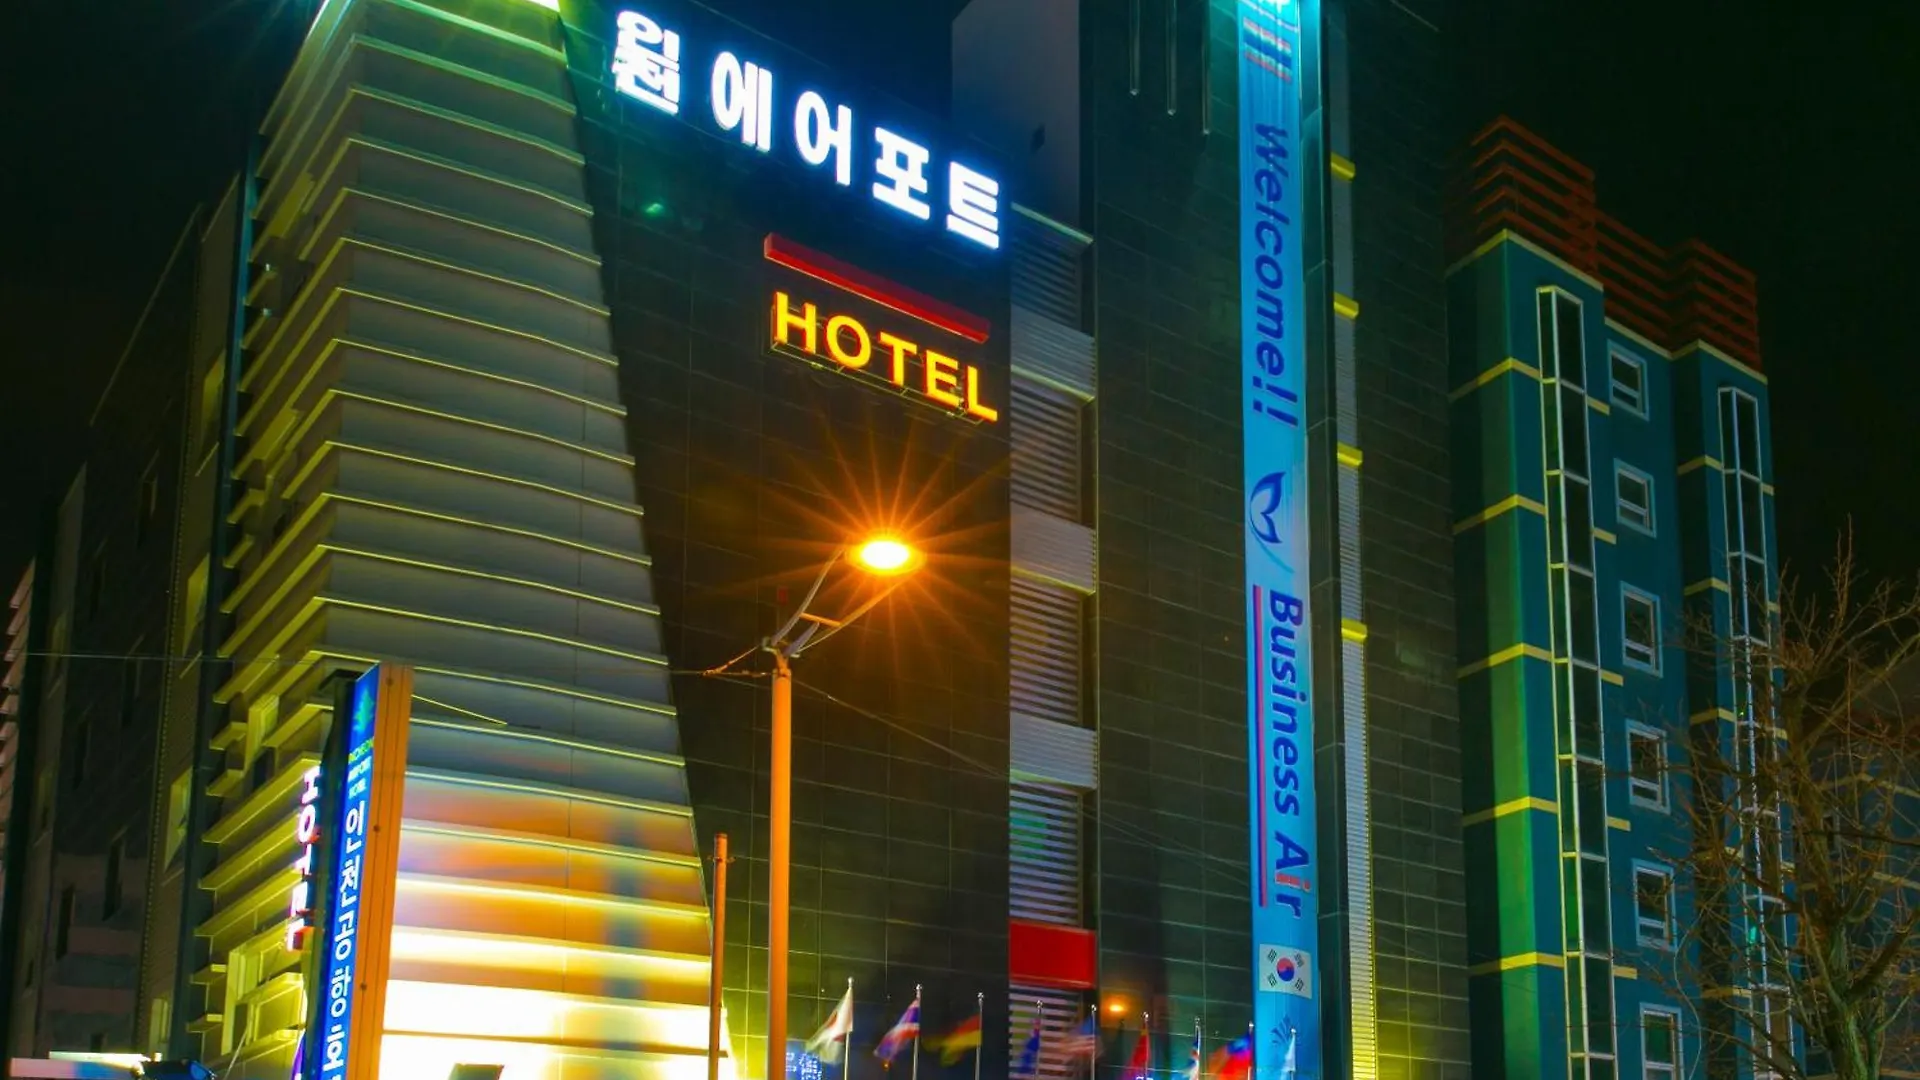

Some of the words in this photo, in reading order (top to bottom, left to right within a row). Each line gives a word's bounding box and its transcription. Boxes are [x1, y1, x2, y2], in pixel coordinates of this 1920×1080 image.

[773, 290, 998, 422] HOTEL
[1252, 122, 1299, 428] Welcome!!
[1269, 589, 1307, 817] Business
[286, 765, 320, 952] HOTEL
[1273, 830, 1312, 919] Air
